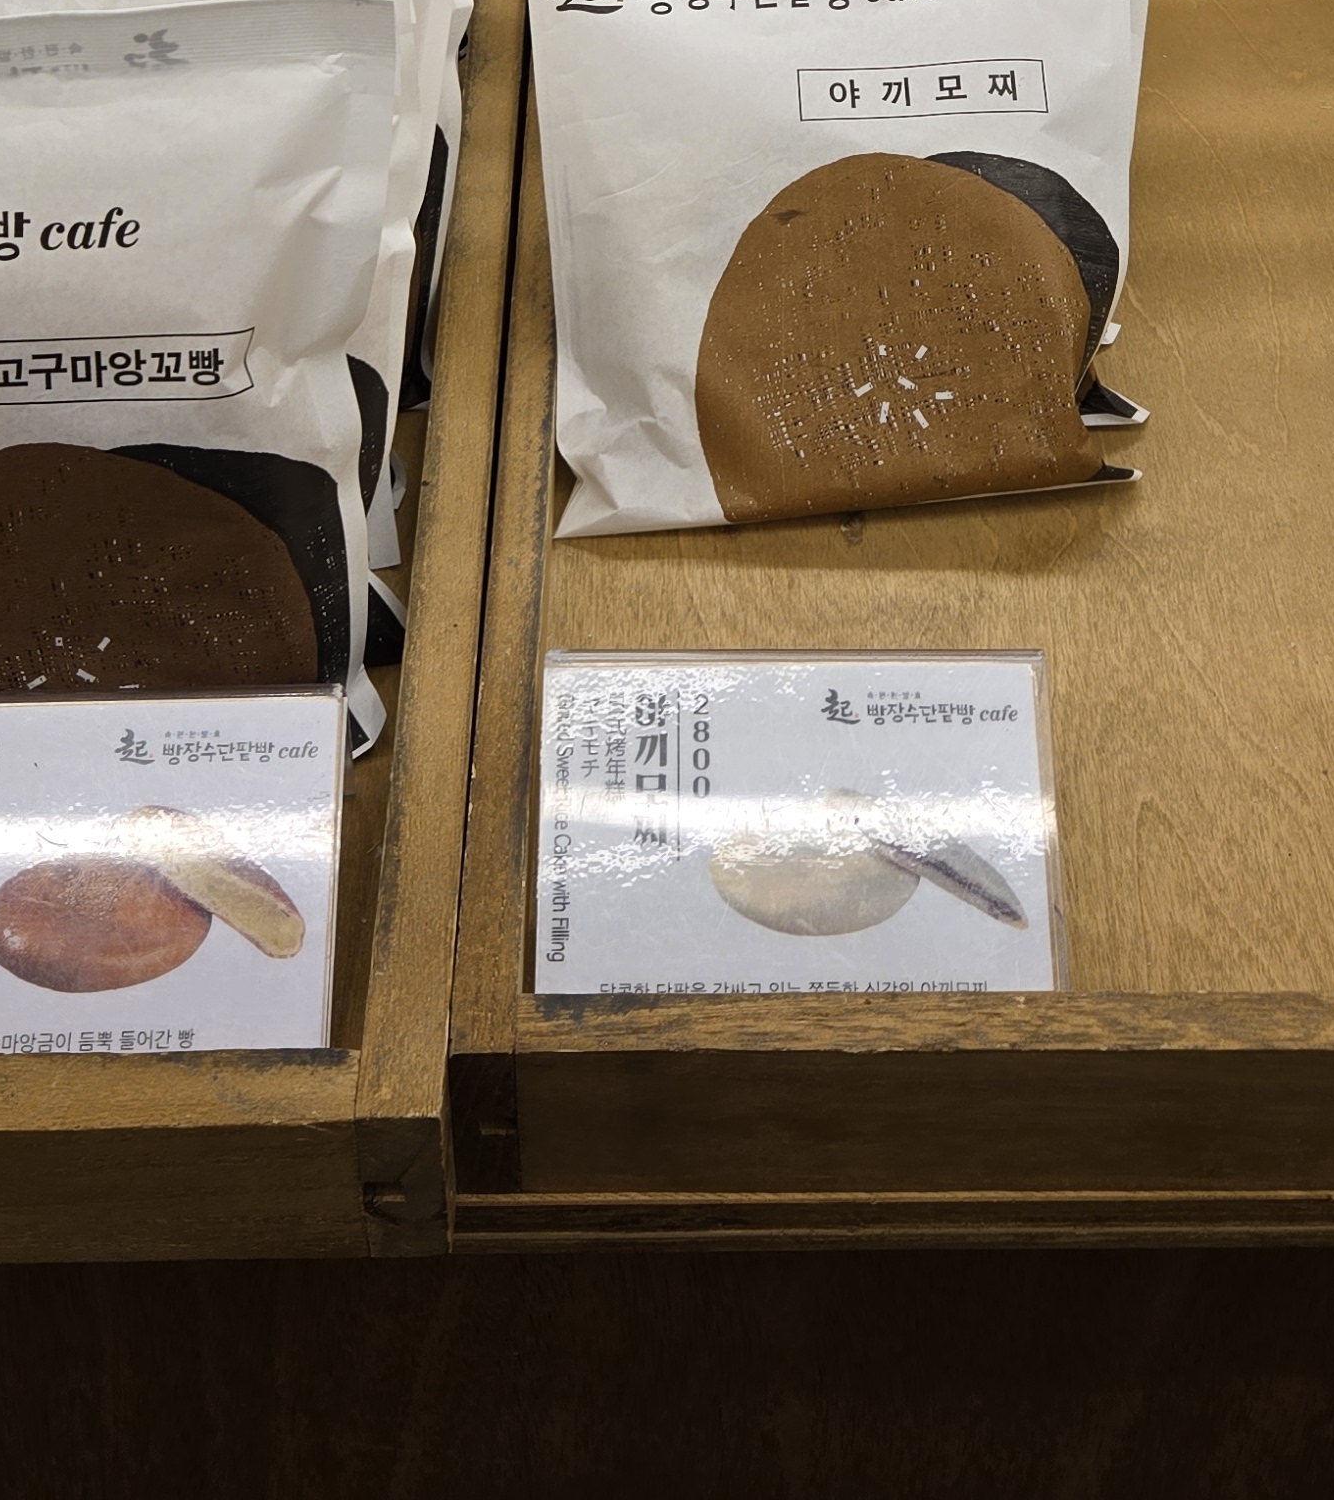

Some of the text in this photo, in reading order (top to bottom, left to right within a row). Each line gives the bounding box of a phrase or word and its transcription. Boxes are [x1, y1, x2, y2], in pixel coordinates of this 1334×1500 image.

[40, 207, 140, 251] cafe
[867, 702, 1018, 725] 빵장수단팥빵 cafe
[162, 741, 318, 765] 빵장수단팥빵 cafe
[693, 693, 710, 799] 2800
[551, 879, 570, 913] with
[546, 918, 570, 963] Filling
[77, 1031, 113, 1051] 듬뿍
[119, 1029, 171, 1049] 들어간
[178, 1029, 194, 1048] 빵
